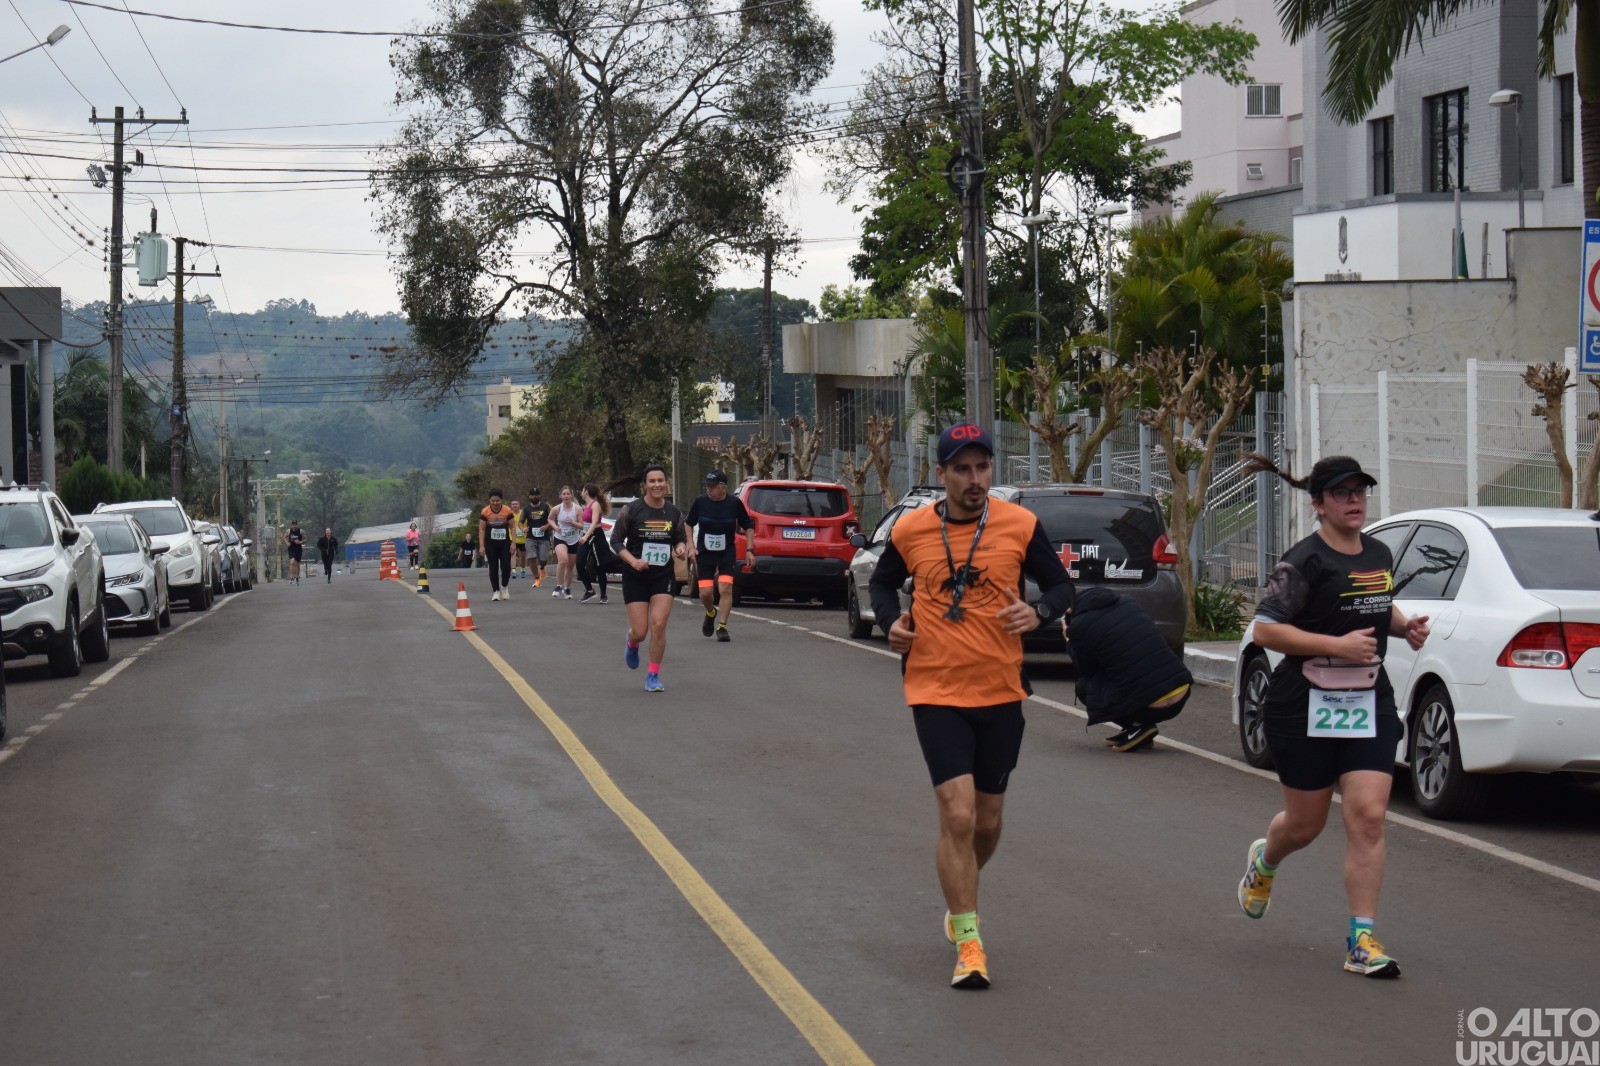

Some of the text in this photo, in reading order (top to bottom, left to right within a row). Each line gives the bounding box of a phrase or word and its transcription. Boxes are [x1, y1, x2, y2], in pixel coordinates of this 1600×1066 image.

[645, 552, 667, 562] 119
[1081, 545, 1099, 559] FIAT
[1315, 708, 1368, 729] 222
